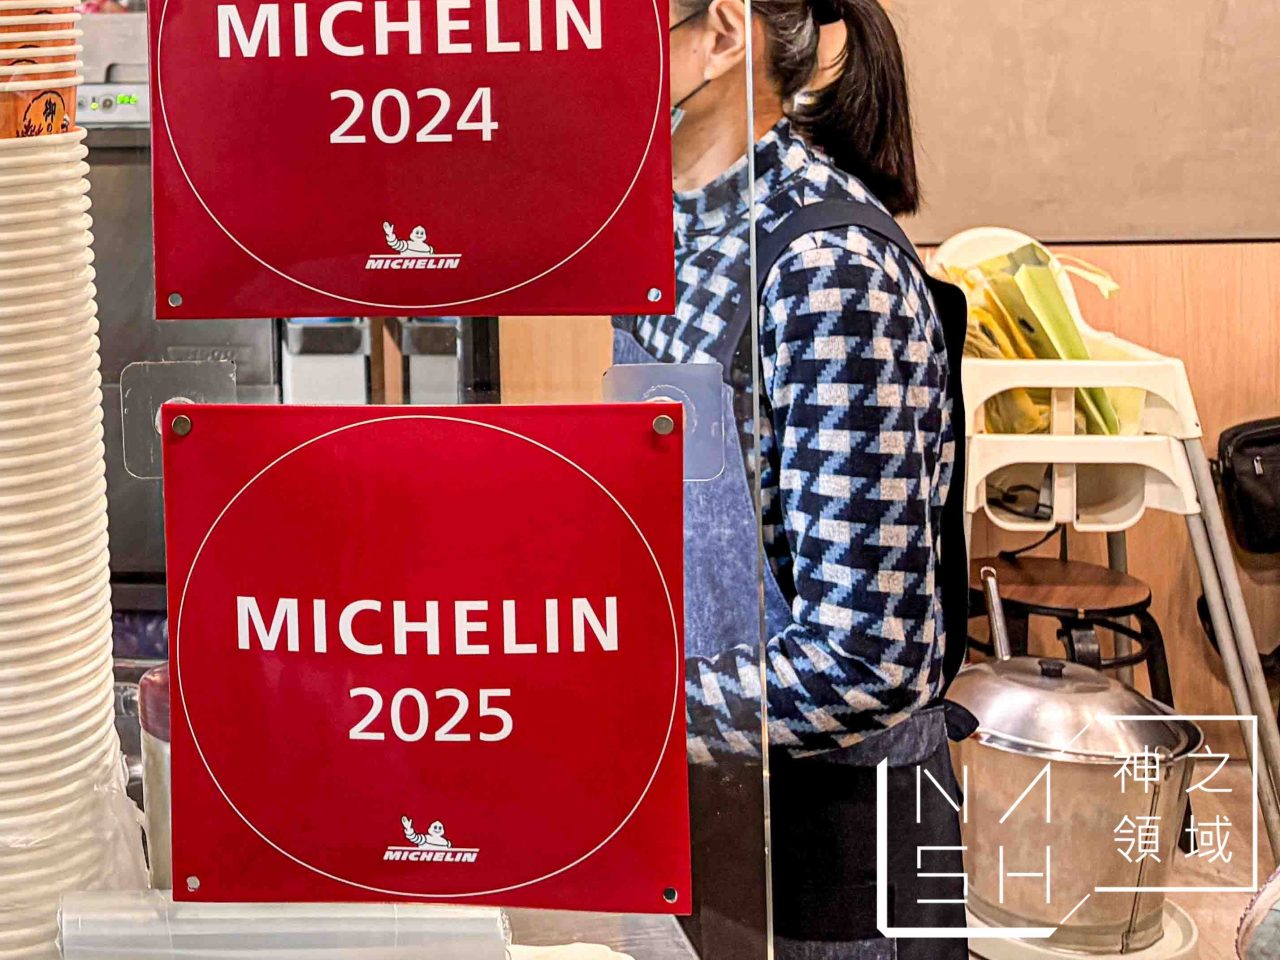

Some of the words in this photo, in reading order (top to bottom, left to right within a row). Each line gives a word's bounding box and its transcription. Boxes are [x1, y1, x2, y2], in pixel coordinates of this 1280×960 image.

[329, 87, 500, 144] 2024
[365, 258, 460, 270] MICHELIN
[236, 595, 619, 656] MICHELIN
[348, 687, 514, 742] 2025
[382, 848, 480, 863] MICHELIN
